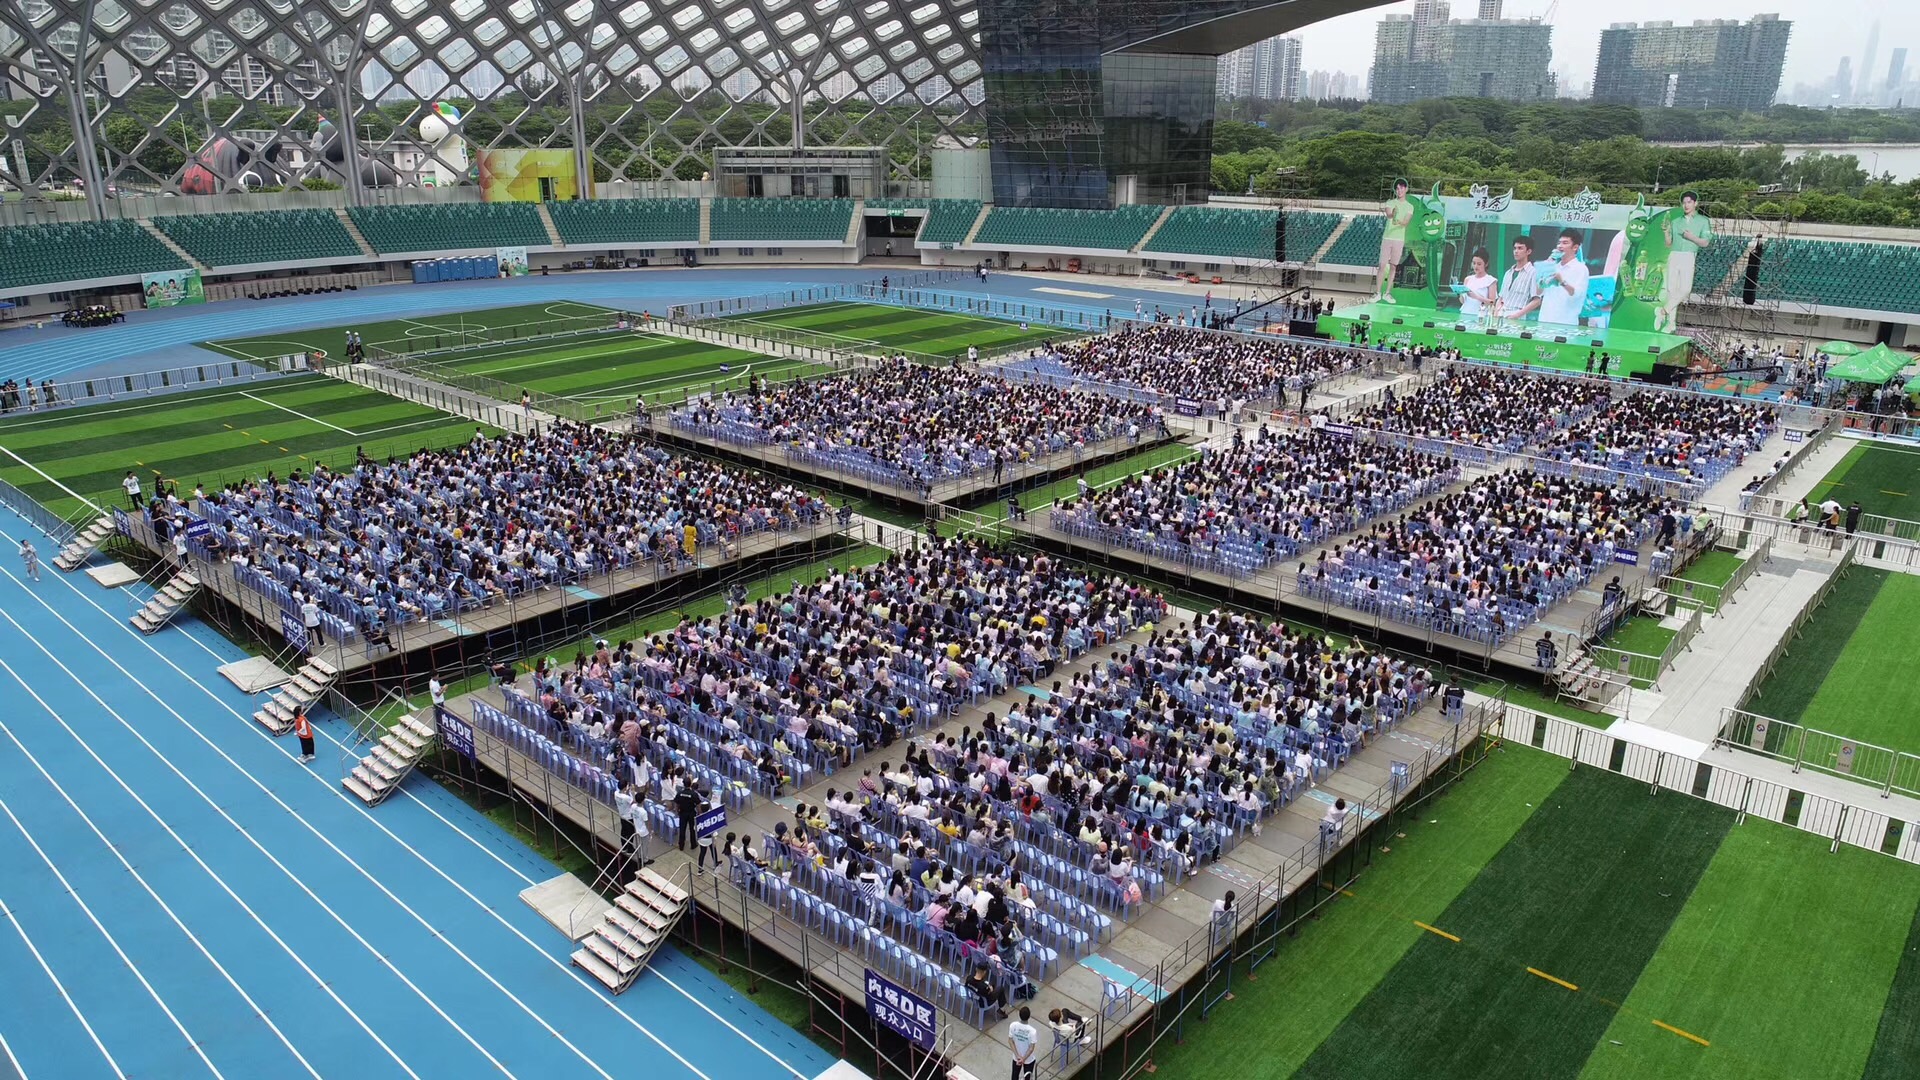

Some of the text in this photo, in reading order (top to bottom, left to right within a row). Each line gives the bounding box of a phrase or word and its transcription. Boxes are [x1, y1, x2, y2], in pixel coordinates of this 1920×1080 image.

[696, 811, 726, 832] 内场D区
[868, 978, 932, 1027] 内场D区
[874, 1003, 923, 1041] 观众入口
